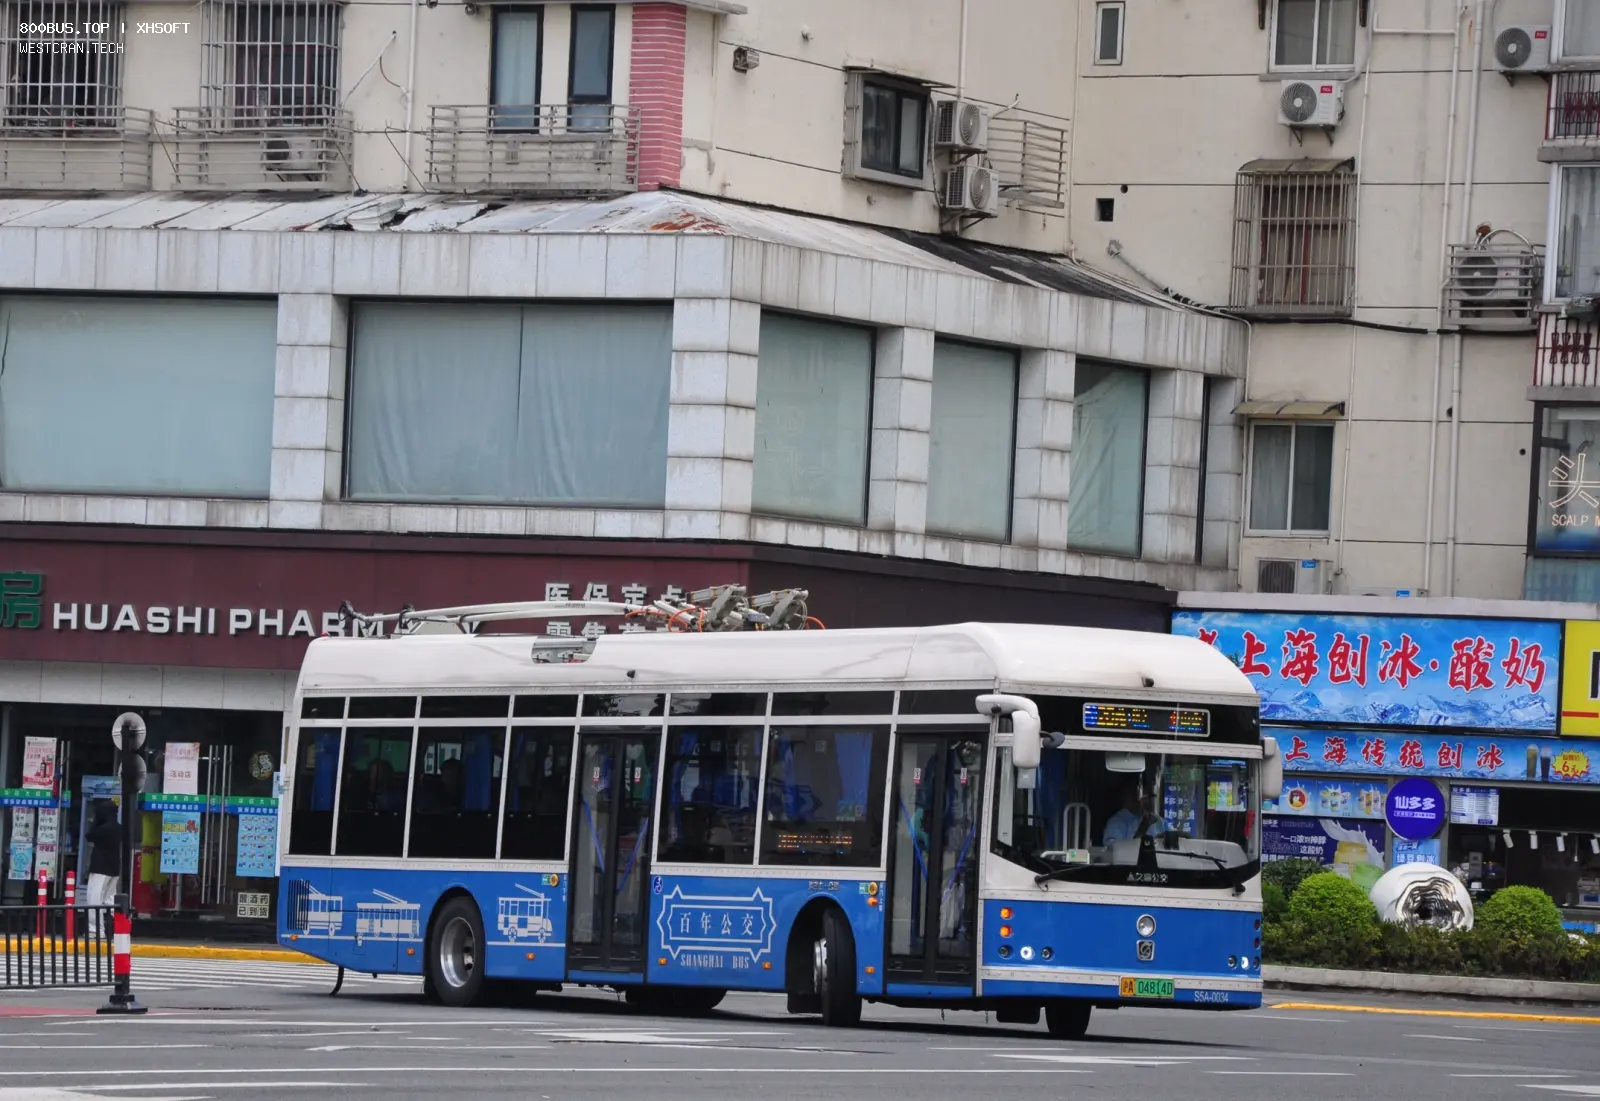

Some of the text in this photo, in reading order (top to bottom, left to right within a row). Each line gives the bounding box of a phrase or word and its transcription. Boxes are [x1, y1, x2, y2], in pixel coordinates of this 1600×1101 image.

[1551, 514, 1589, 526] SCALP
[53, 602, 216, 634] HUASHI
[1199, 628, 1547, 695] 上海刨冰·酸奶
[1285, 736, 1504, 771] 上海传统刨冰
[1562, 761, 1579, 774] 6元
[1394, 795, 1436, 811] 仙多多
[238, 906, 268, 916] 已到货
[680, 912, 754, 936] 百年公交
[680, 954, 749, 969] SHANGHAI BUS
[1194, 990, 1229, 1003] S5A-0034
